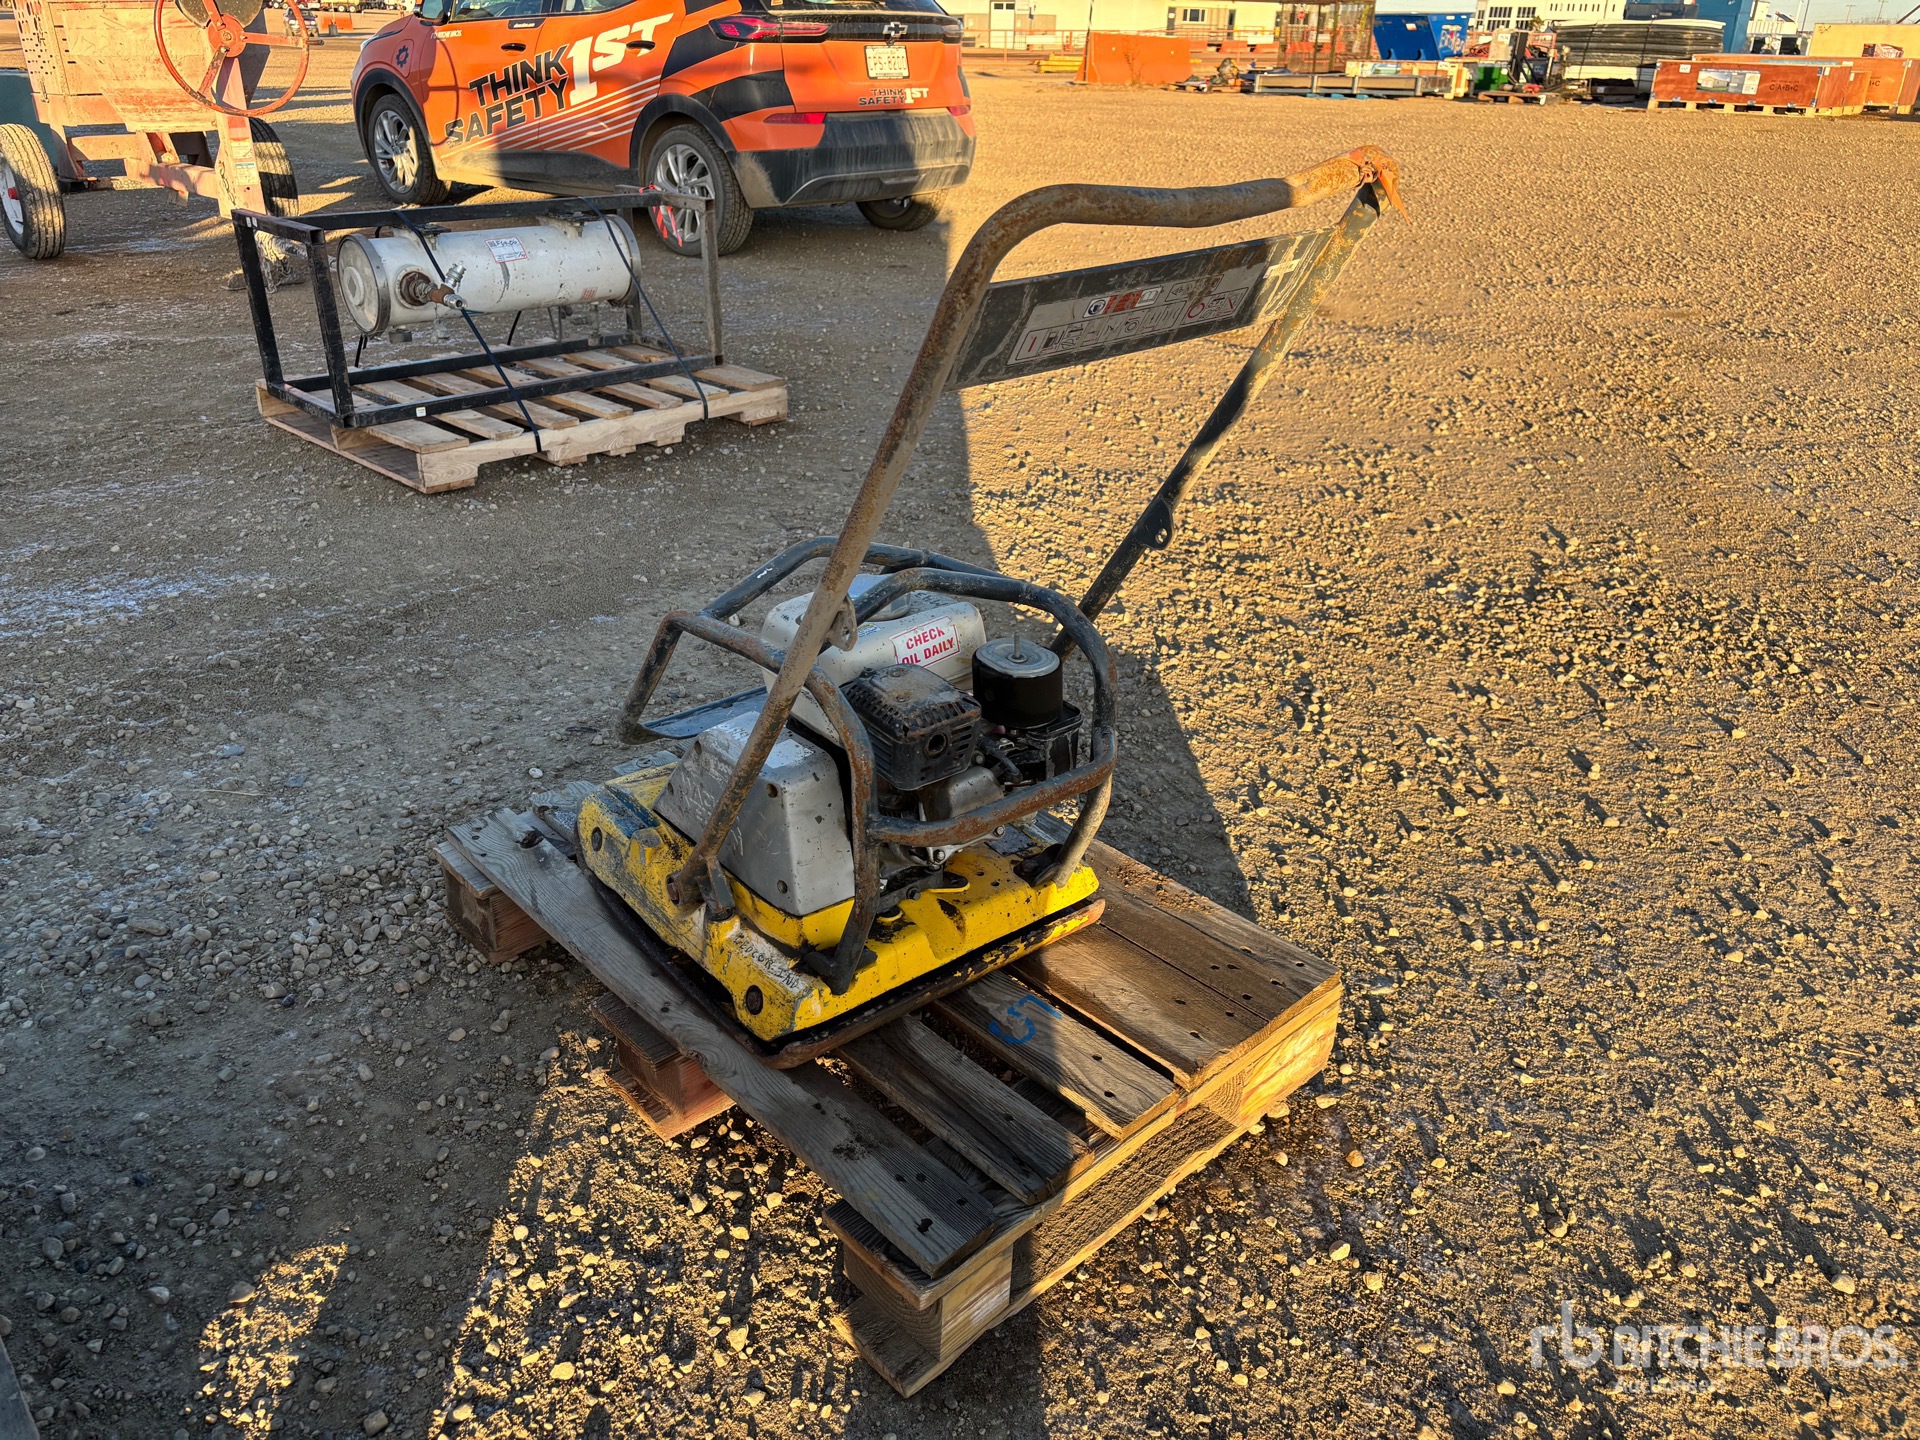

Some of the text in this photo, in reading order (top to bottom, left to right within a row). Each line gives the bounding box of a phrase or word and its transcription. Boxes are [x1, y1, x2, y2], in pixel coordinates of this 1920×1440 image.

[566, 13, 675, 106] 1ST
[468, 44, 570, 107] THINK
[859, 96, 905, 106] SAFETY
[871, 88, 904, 96] THINK
[904, 87, 929, 104] 1ST
[445, 76, 569, 145] SAFETY
[905, 626, 945, 650] CHECK
[923, 637, 955, 660] DAILY
